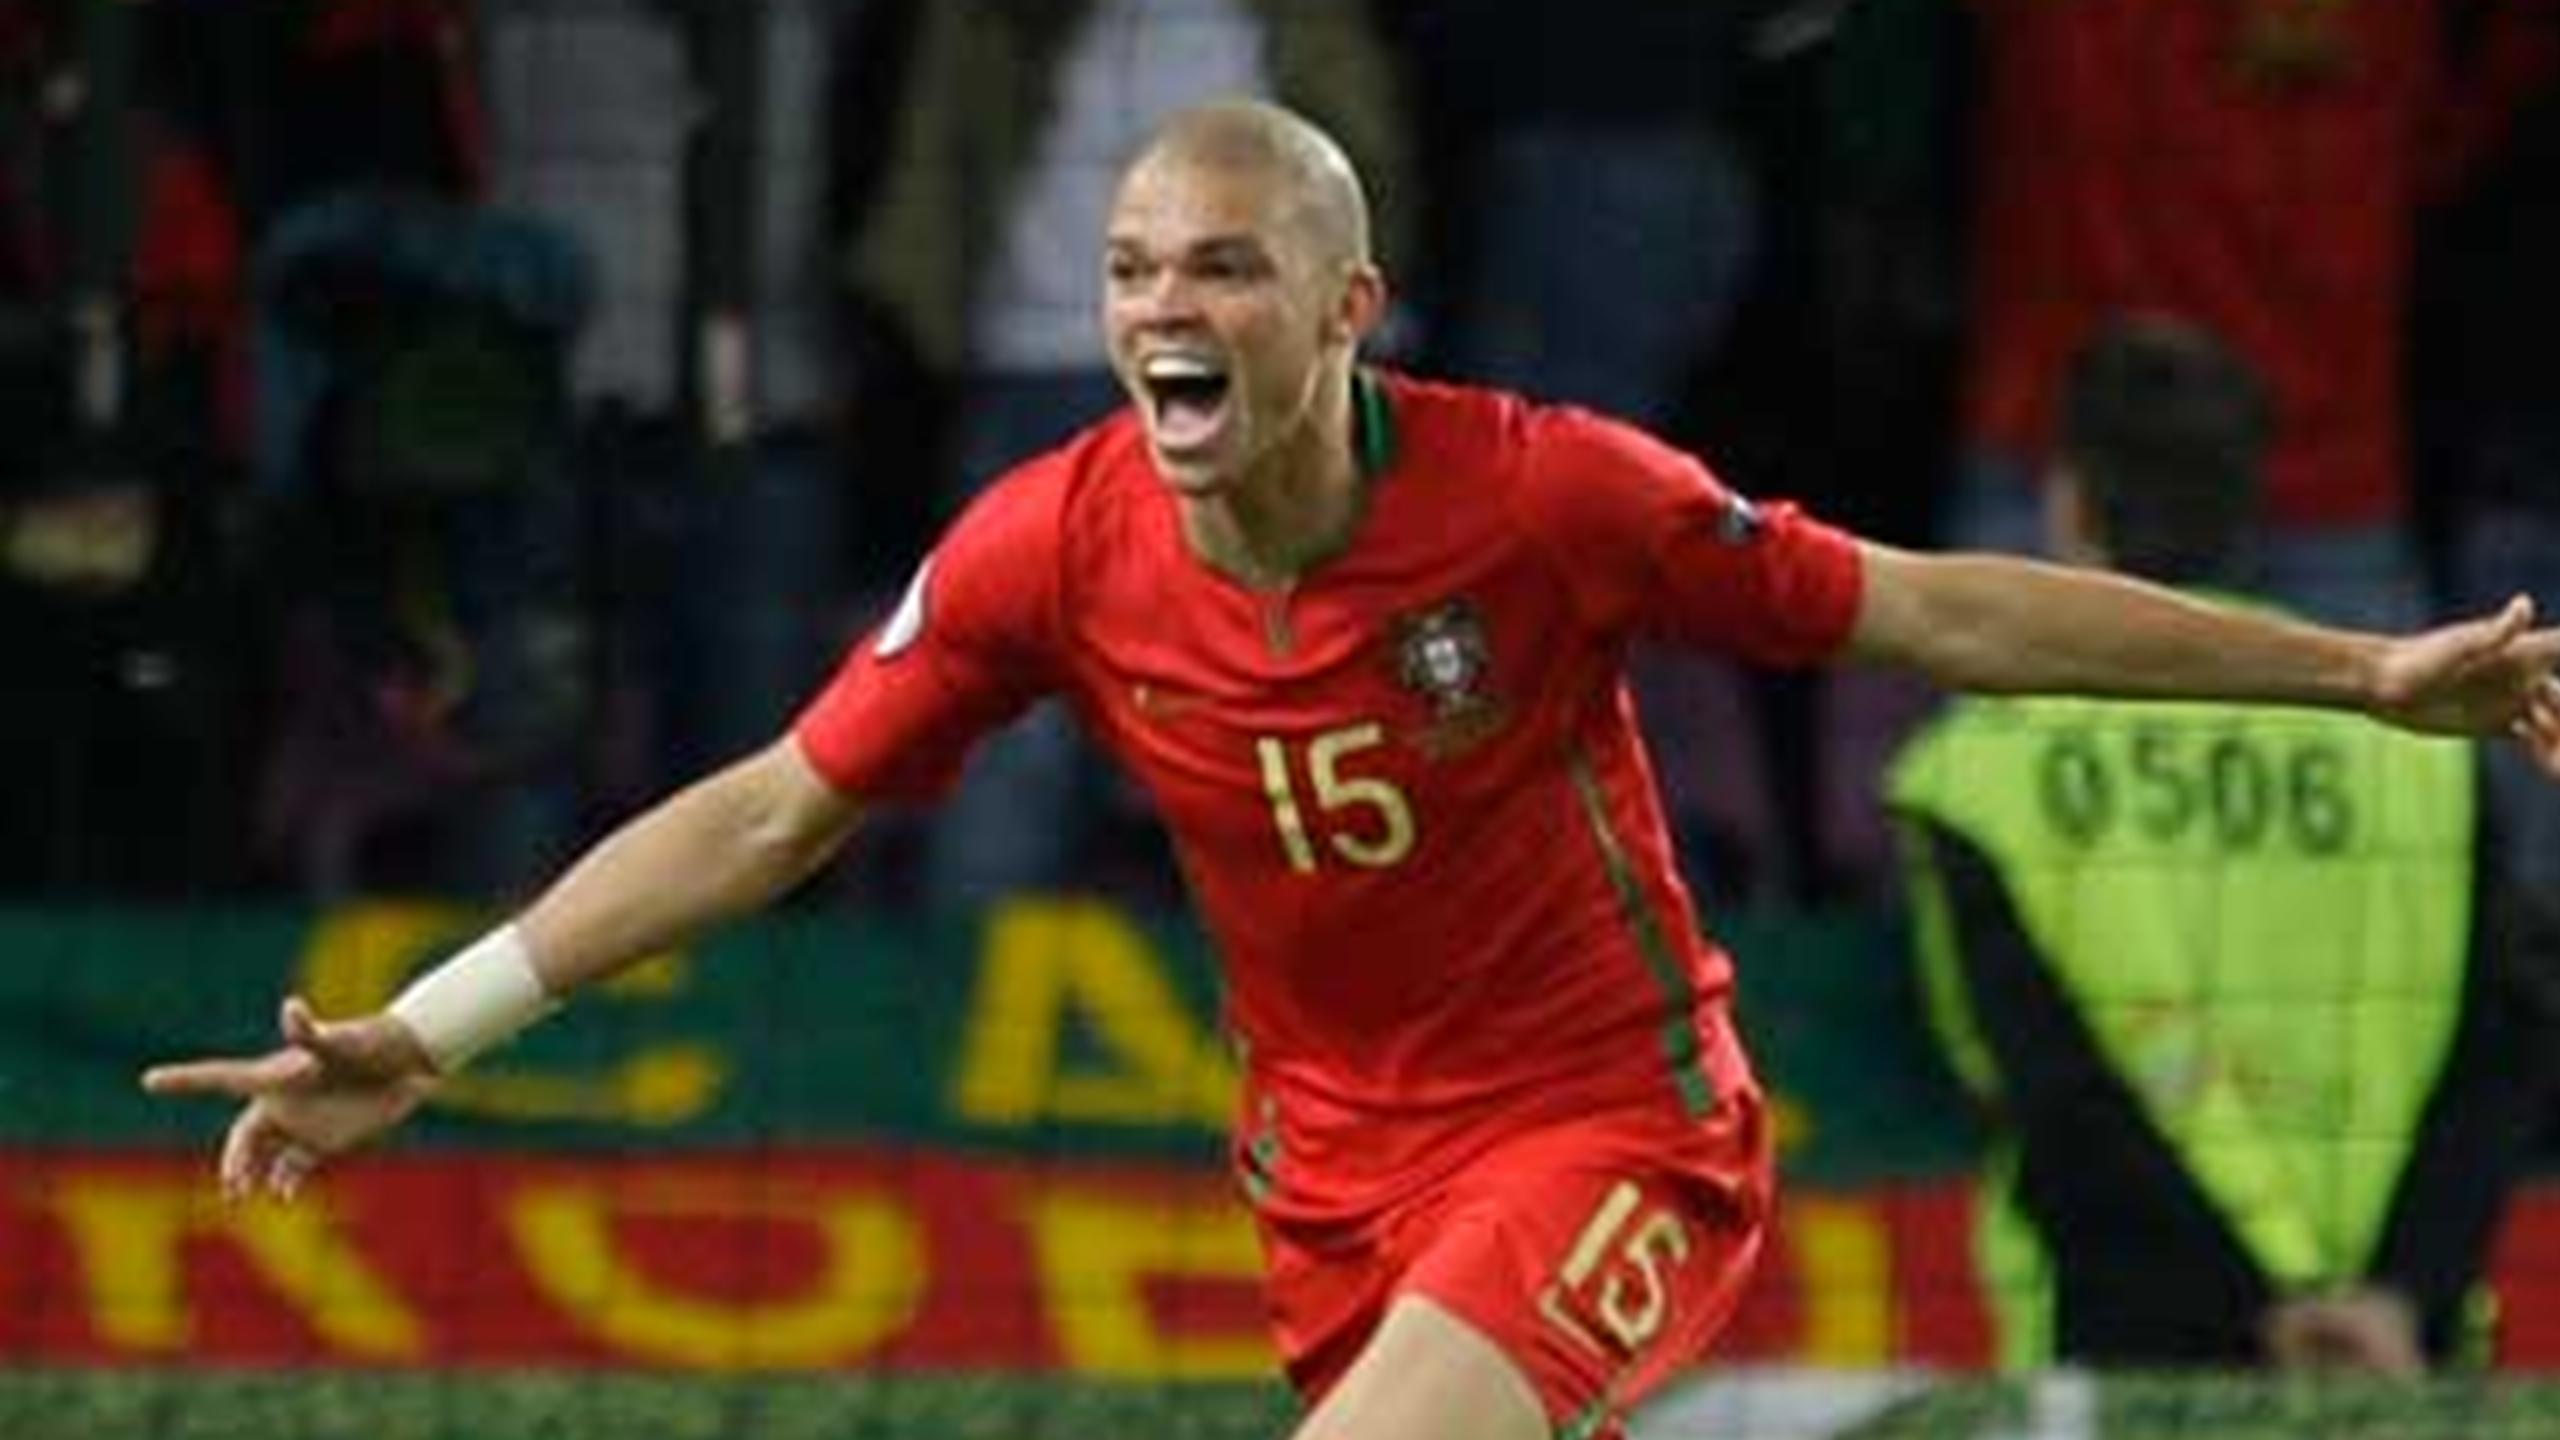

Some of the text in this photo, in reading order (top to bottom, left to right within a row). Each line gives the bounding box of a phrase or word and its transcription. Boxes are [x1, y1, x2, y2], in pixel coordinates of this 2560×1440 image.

[1255, 722, 1415, 875] 15
[2039, 722, 2356, 857] 0506
[1540, 1178, 1689, 1352] 15
